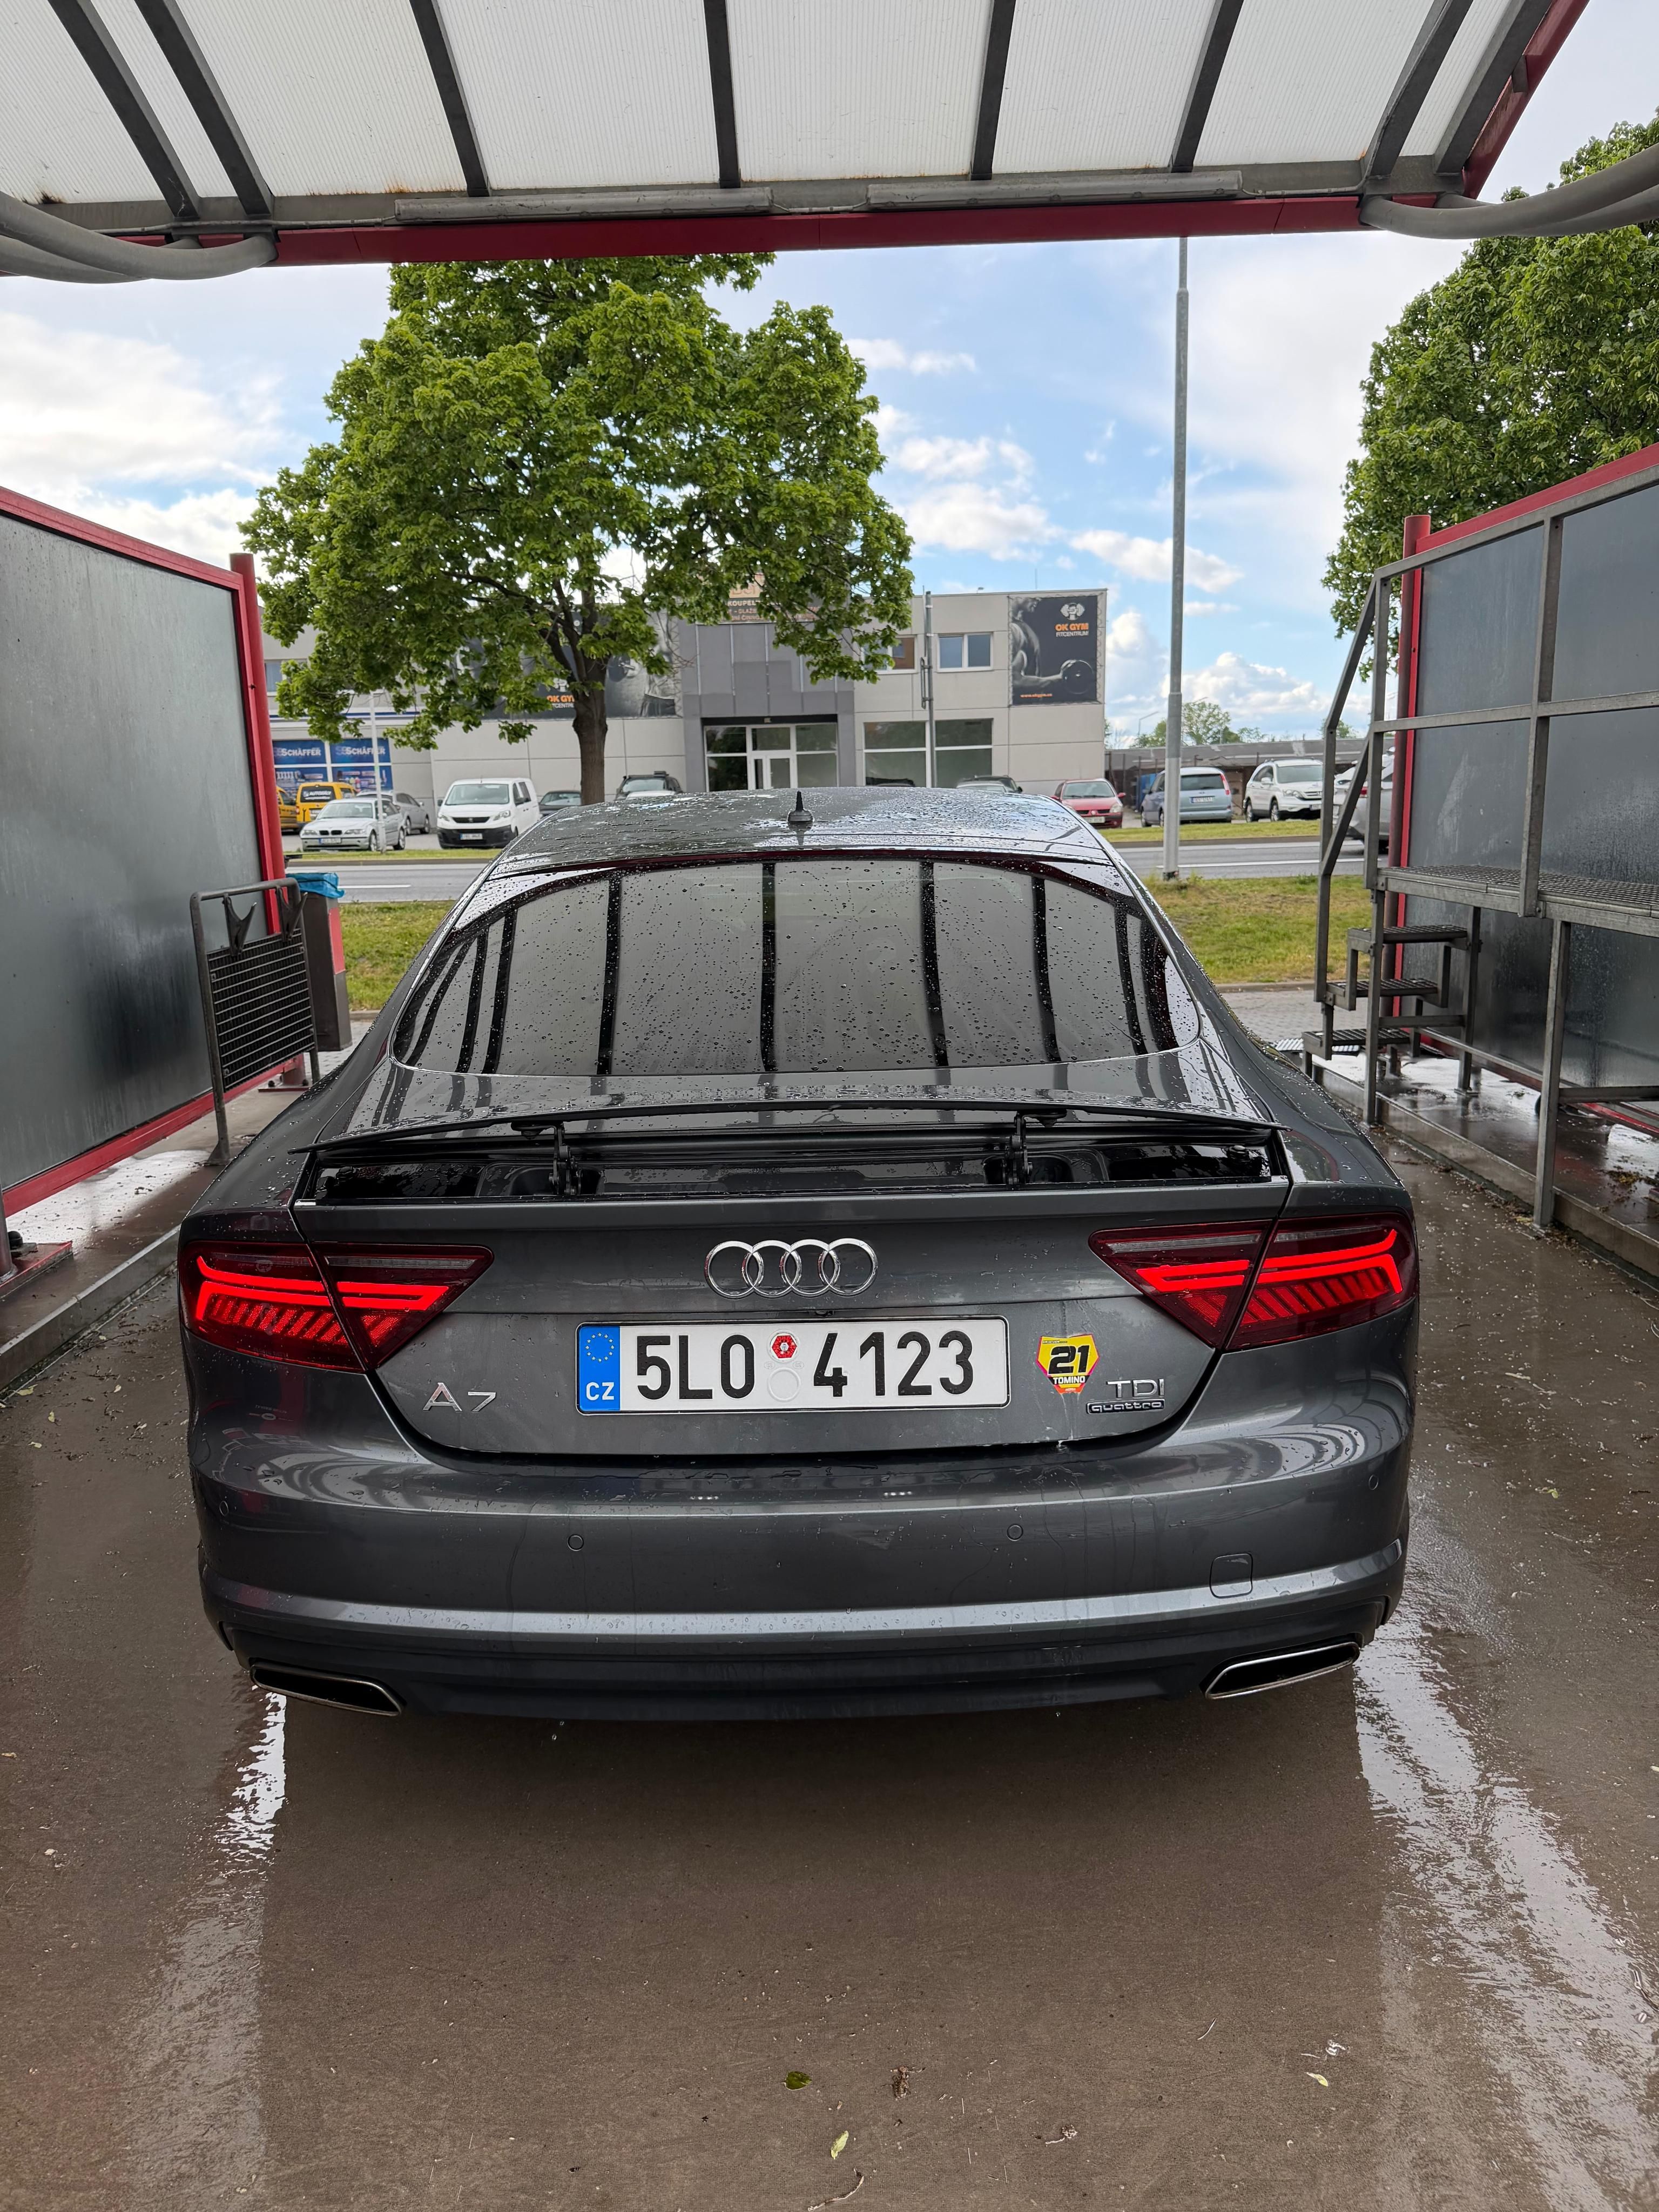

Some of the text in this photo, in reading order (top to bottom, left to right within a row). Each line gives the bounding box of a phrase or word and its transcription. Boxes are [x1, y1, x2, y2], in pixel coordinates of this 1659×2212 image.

[637, 1330, 973, 1400] 5L0 4123
[1048, 1345, 1090, 1374] 21
[1053, 1376, 1085, 1384] TOMINO
[1107, 1379, 1164, 1398] TDI
[586, 1381, 615, 1400] CZ
[1091, 1402, 1162, 1413] quattro
